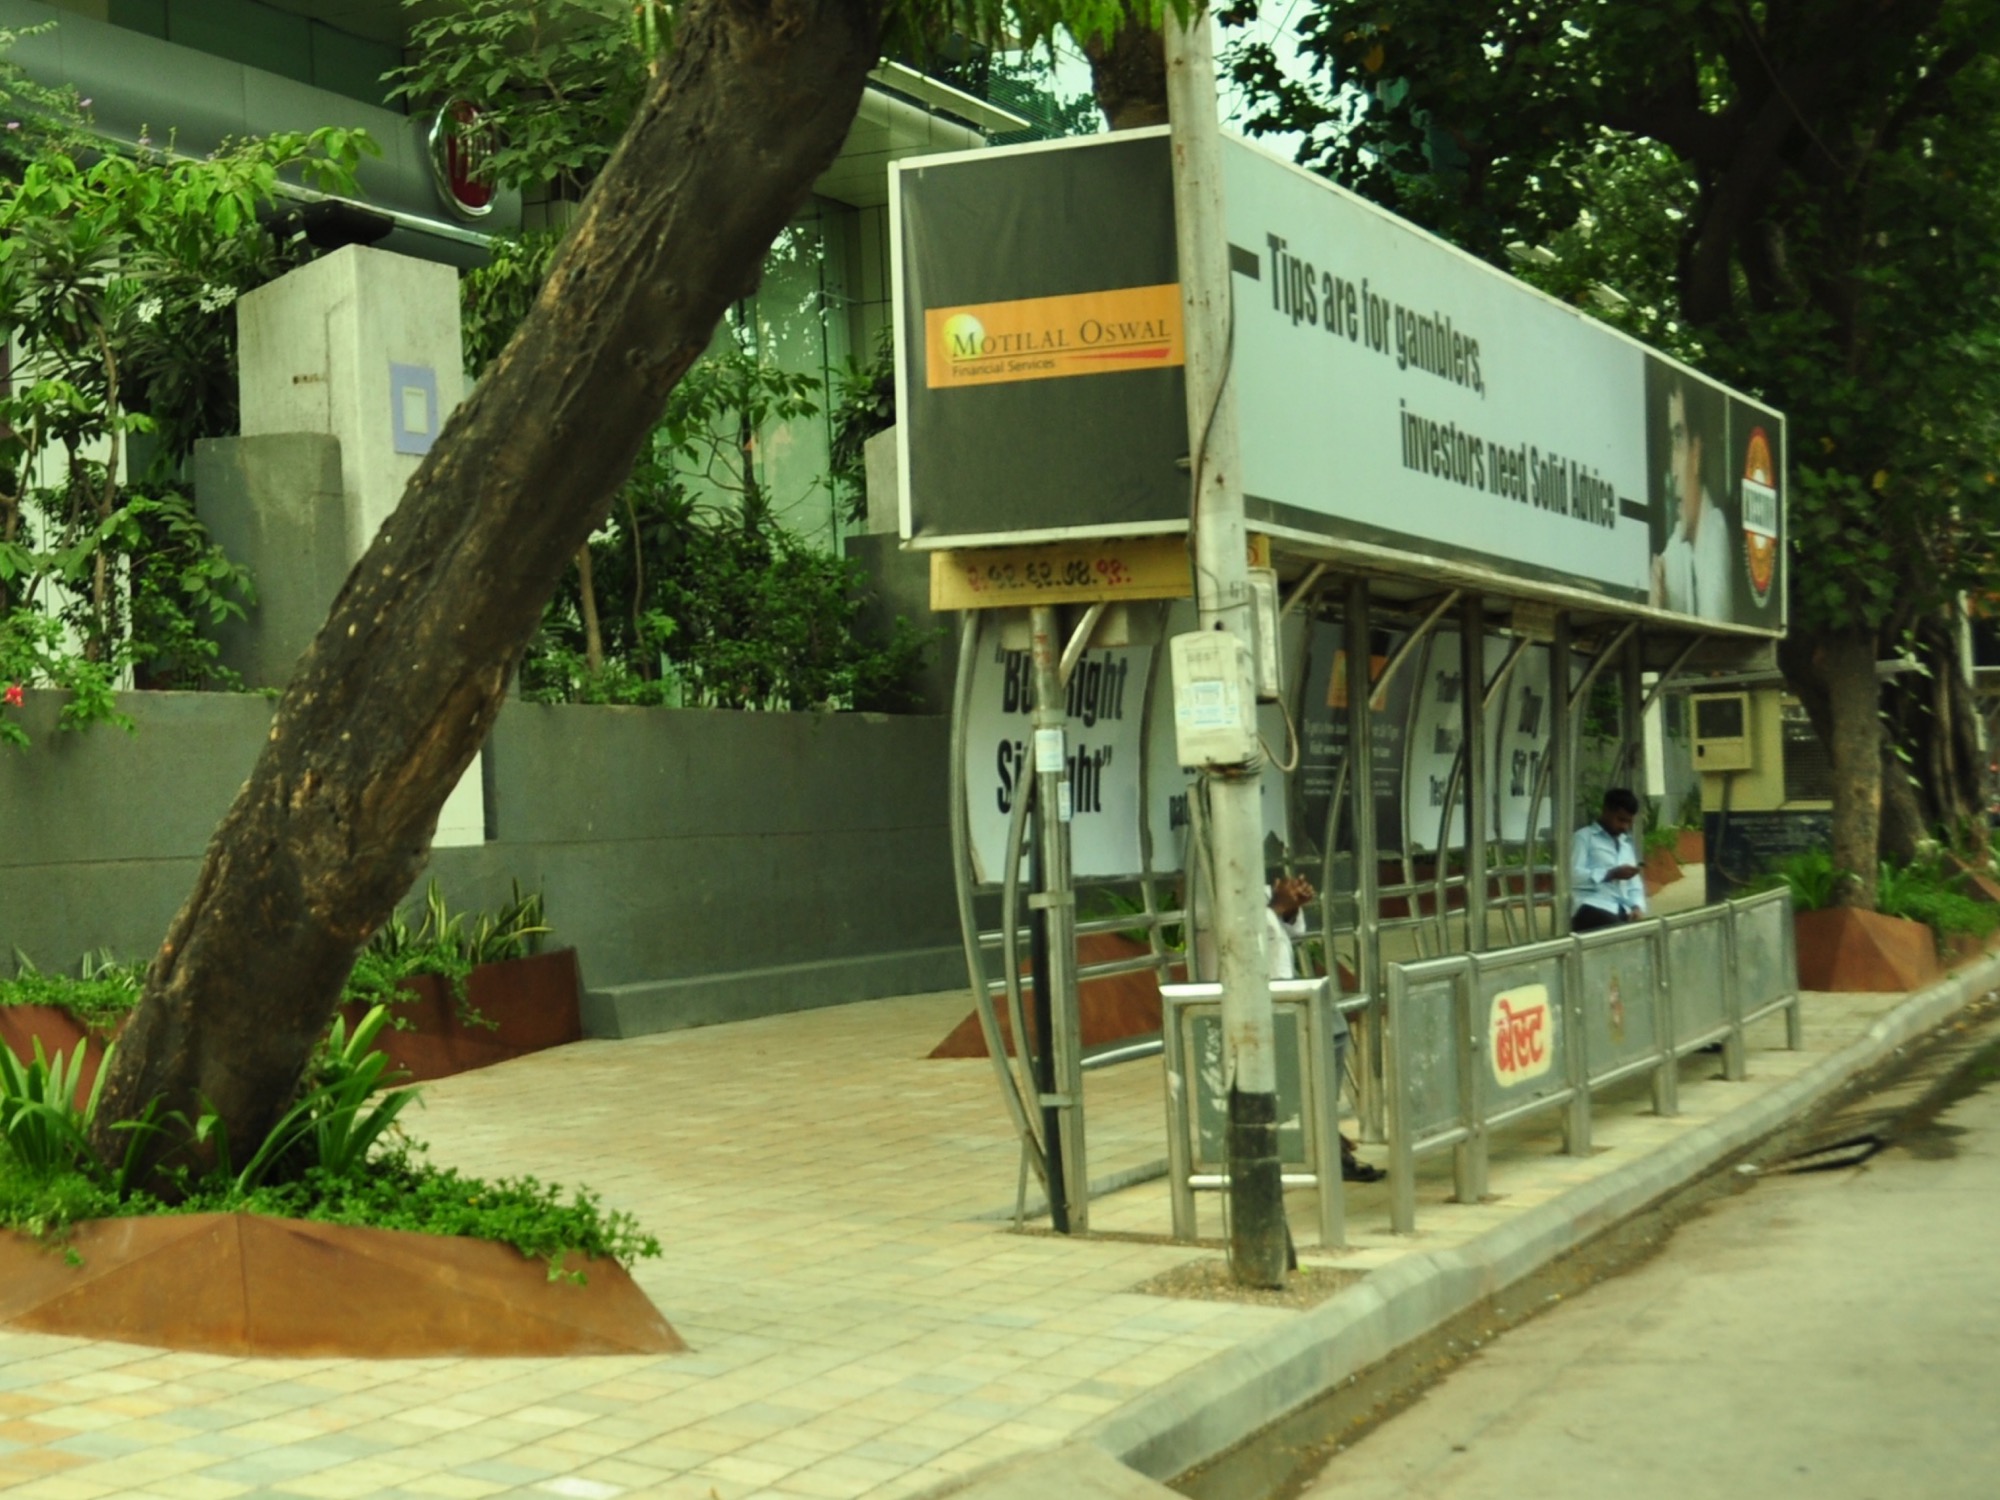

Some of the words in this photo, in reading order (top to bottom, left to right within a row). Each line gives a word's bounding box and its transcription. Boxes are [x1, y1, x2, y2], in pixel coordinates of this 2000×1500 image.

[952, 330, 1070, 358] MOTILAL
[1079, 318, 1172, 345] OSWAL
[1267, 232, 1318, 328] Tips
[1322, 271, 1358, 343] are
[1361, 277, 1390, 356] for
[1395, 303, 1486, 400] gamblers,
[952, 359, 1008, 378] Financial
[1008, 357, 1056, 373] Services
[1400, 397, 1485, 492] investors
[1488, 441, 1529, 504] need
[1530, 445, 1569, 516] Solid
[1571, 459, 1616, 530] Advice
[1496, 998, 1545, 1073] बेस्ट
